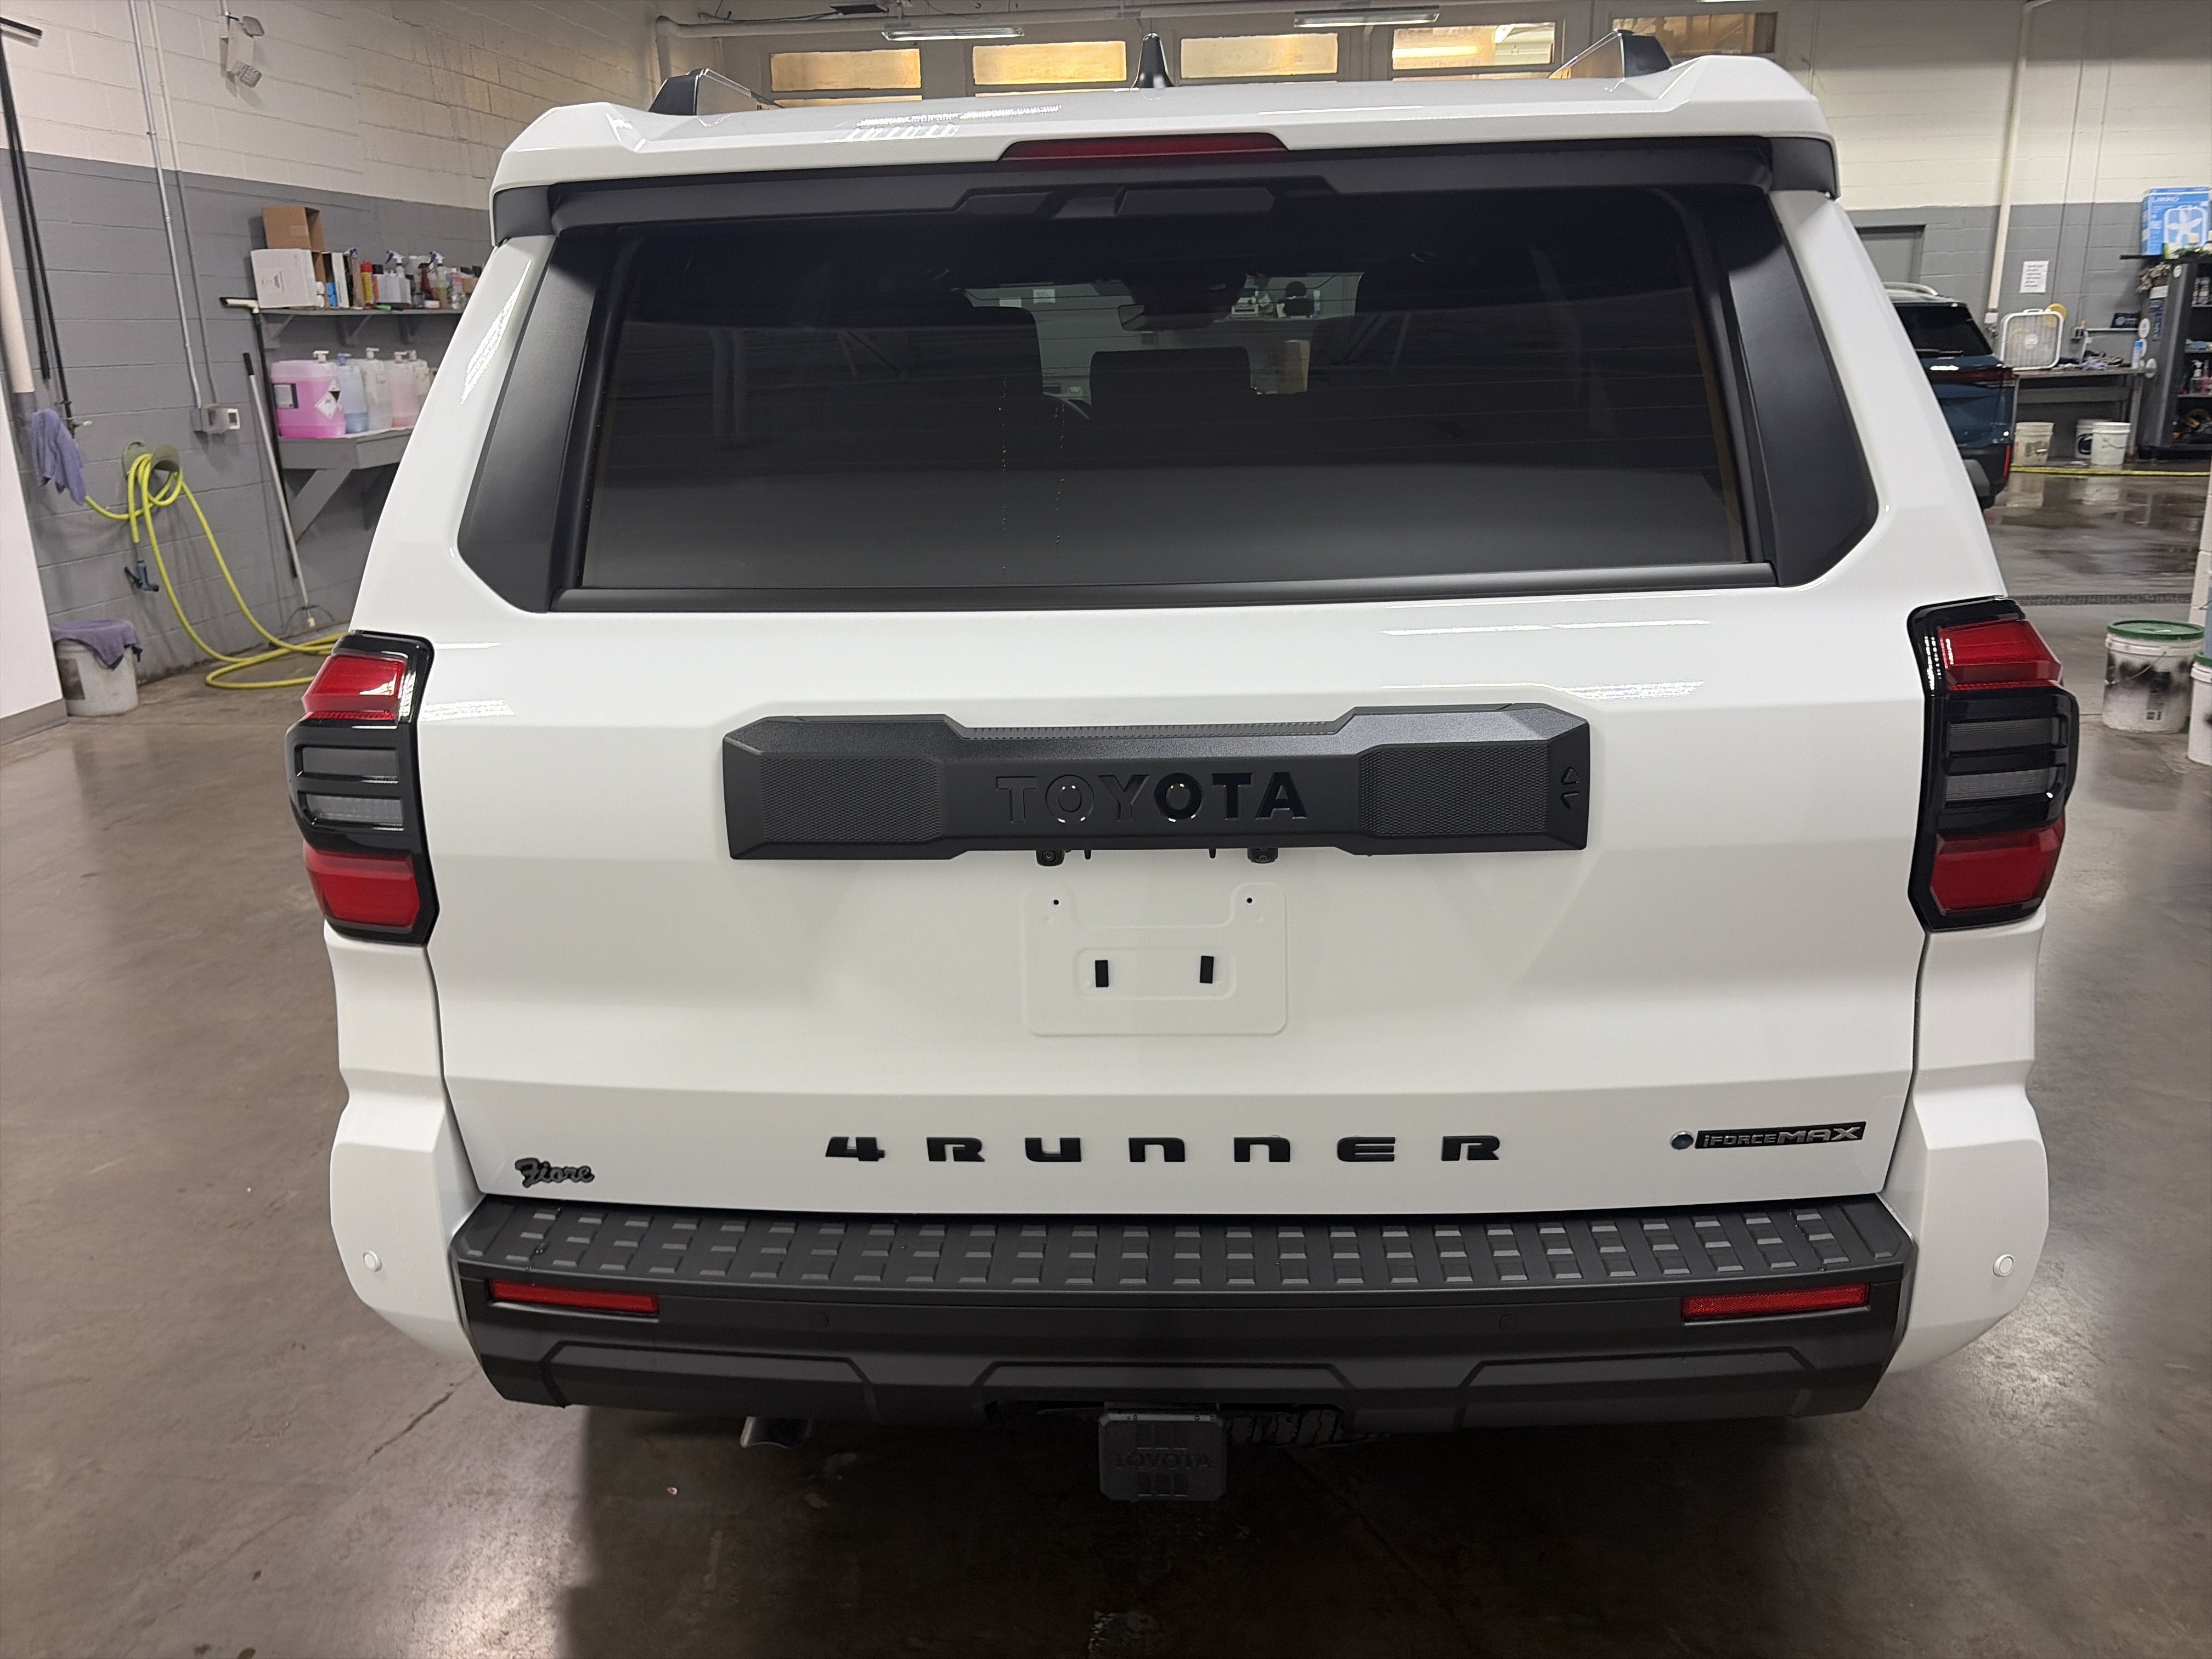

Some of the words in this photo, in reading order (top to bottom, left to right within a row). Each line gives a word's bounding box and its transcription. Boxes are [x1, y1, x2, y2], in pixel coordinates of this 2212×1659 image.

[995, 771, 1308, 823] TOYOTA
[825, 1136, 1500, 1163] 4RUNNER
[515, 1157, 595, 1188] Fiore
[1113, 1452, 1214, 1470] TOYOTA
